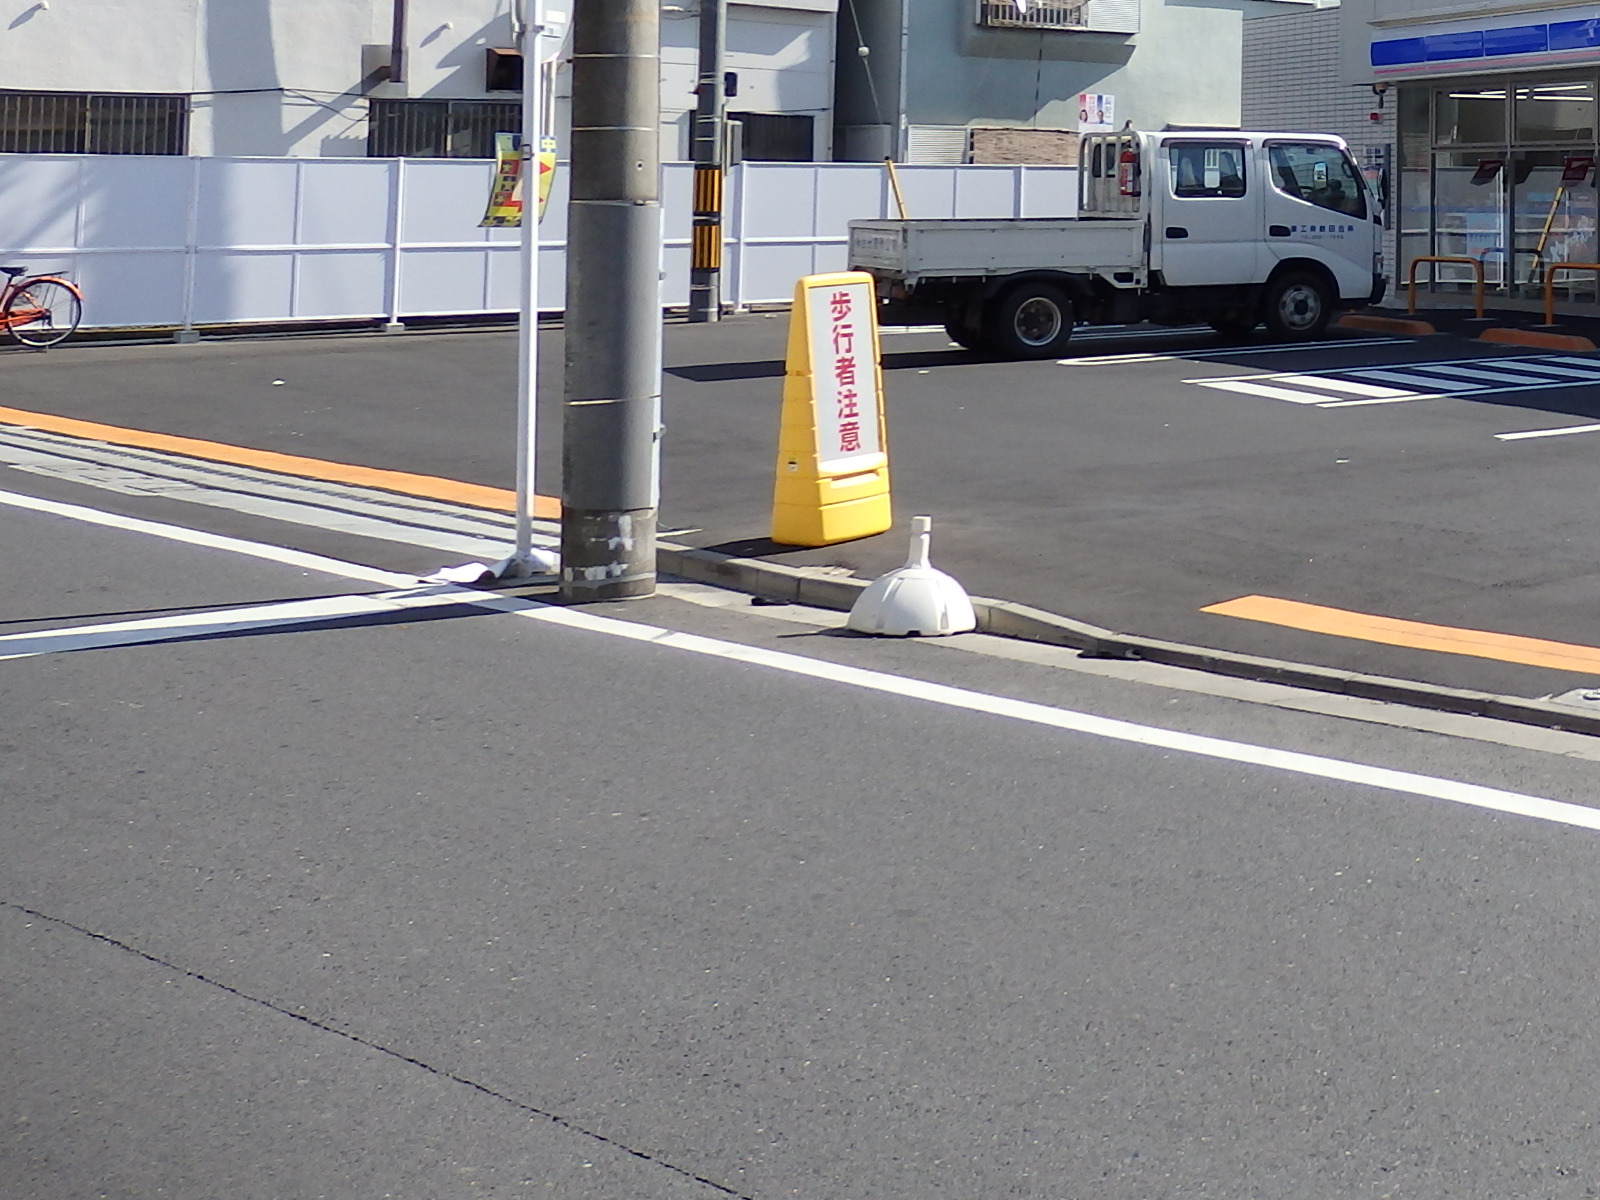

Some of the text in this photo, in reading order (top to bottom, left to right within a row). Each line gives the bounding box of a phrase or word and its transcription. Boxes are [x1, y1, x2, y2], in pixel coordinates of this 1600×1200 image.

[830, 291, 862, 452] 歩行者注意
